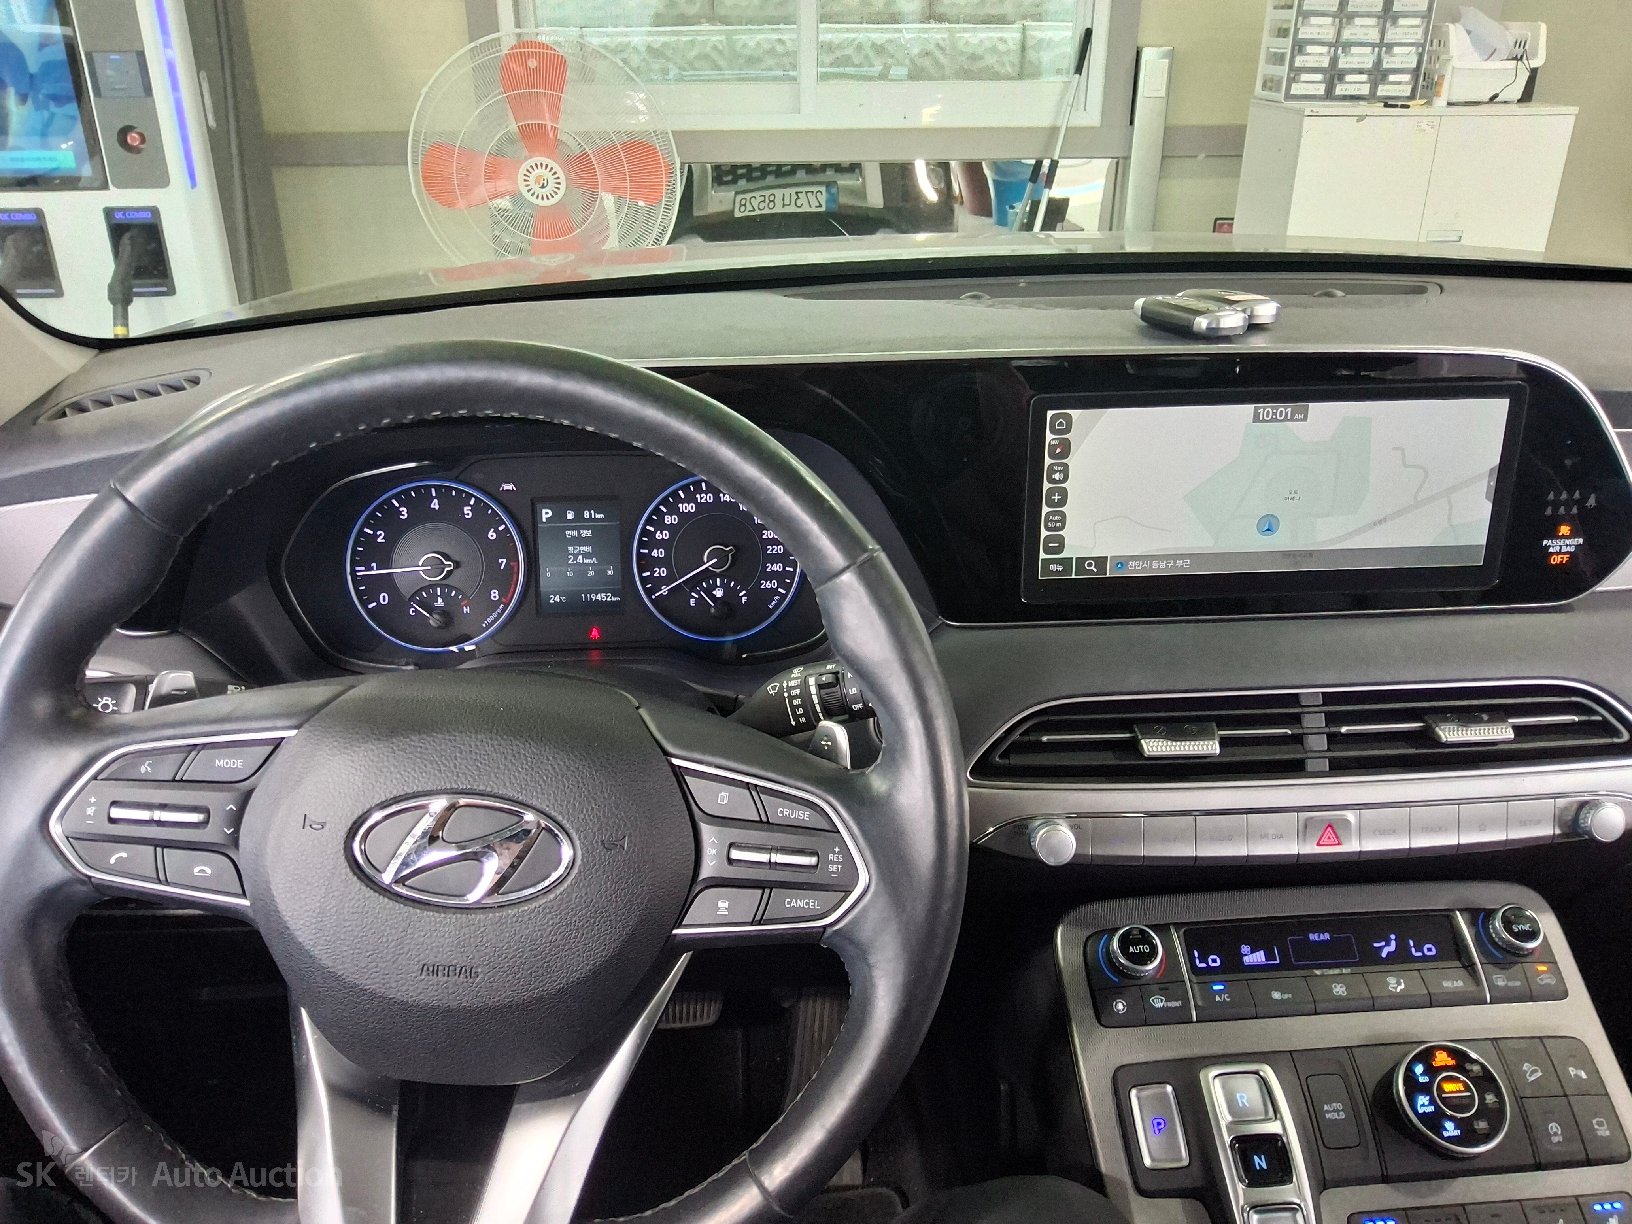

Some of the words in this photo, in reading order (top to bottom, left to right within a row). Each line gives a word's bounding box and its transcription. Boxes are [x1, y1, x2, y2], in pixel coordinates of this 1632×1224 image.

[1258, 408, 1291, 420] 10:01
[696, 493, 713, 503] 120
[430, 499, 439, 510] 4
[678, 503, 695, 513] 100
[399, 507, 408, 519] 3
[463, 507, 472, 519] 5
[541, 508, 553, 522] P
[664, 516, 678, 524] 80
[376, 531, 385, 543] 2
[488, 528, 497, 540] 6
[655, 531, 669, 539] 60
[1542, 538, 1584, 546] PASSENGER
[651, 549, 665, 558] 40
[766, 545, 783, 554] 220
[498, 558, 507, 570] 7
[1128, 560, 1150, 570] 천안시
[1176, 559, 1191, 568] 부근
[1550, 554, 1570, 565] OFF
[653, 568, 667, 577] 20
[766, 563, 783, 572] 240
[760, 580, 777, 589] 260
[379, 593, 389, 605] 0
[490, 589, 499, 601] 8
[689, 598, 696, 606] E
[741, 596, 748, 605] F
[409, 608, 416, 616] C
[215, 759, 243, 769] MODE
[777, 807, 810, 821] CRUISE
[828, 854, 843, 862] RES
[828, 864, 842, 872] SET
[784, 898, 820, 909] CANCEL
[1512, 924, 1532, 932] SYNC
[1308, 932, 1330, 941] REAR
[1129, 944, 1150, 953] AUTO
[1215, 993, 1231, 1002] A/C
[1236, 1092, 1249, 1107] R
[1323, 1102, 1343, 1111] AUTO
[1325, 1111, 1346, 1119] HOLD
[1151, 1117, 1166, 1135] P
[1253, 1154, 1268, 1171] N
